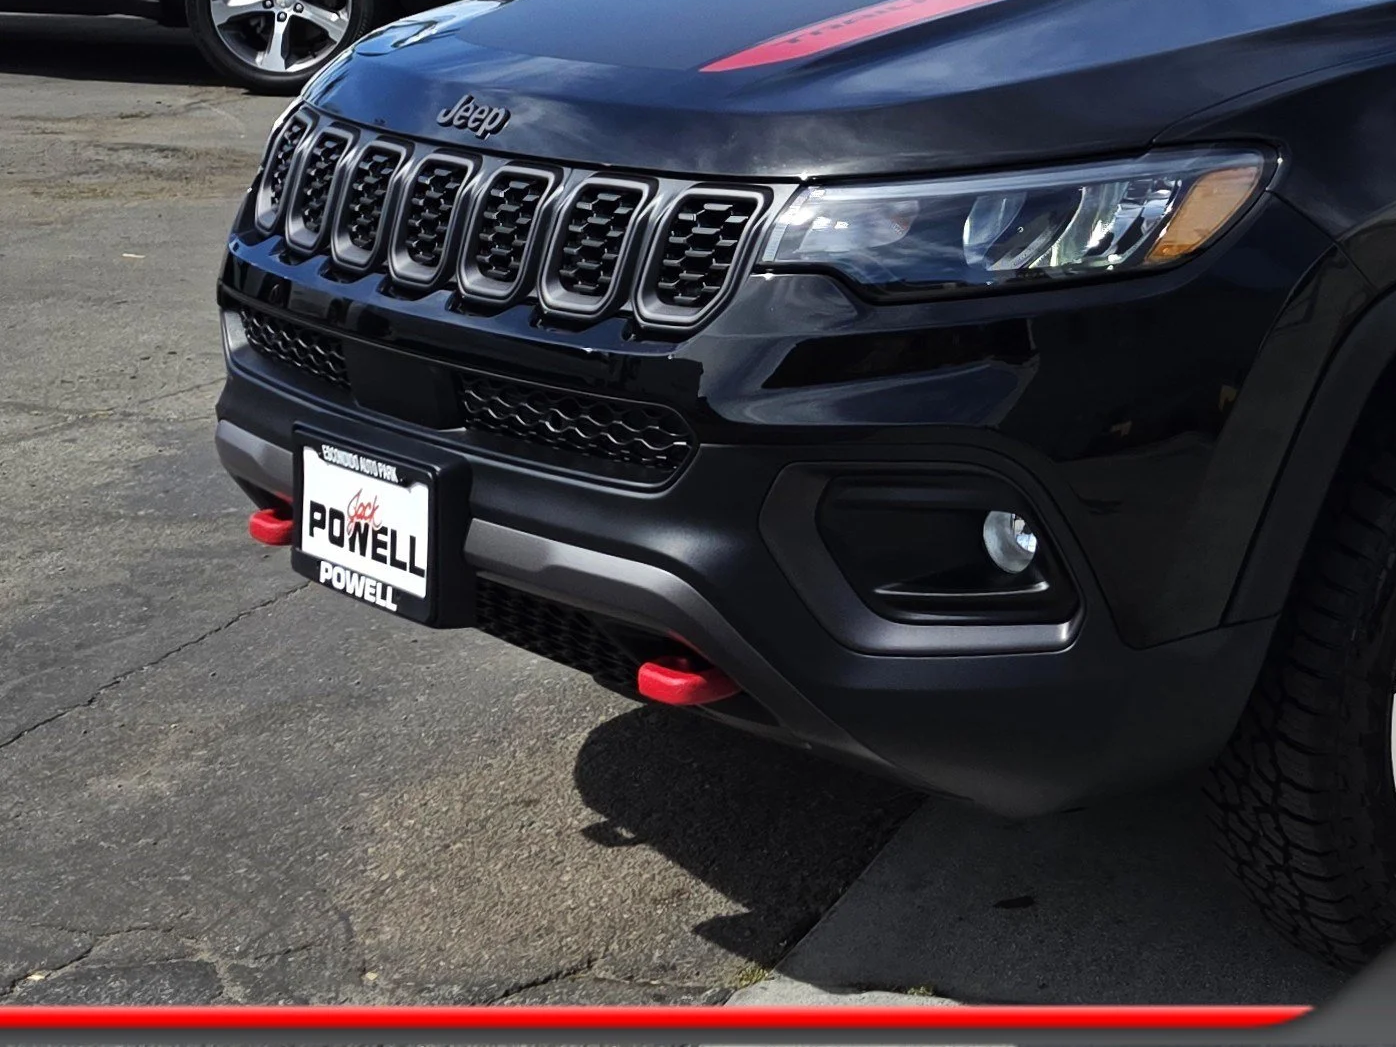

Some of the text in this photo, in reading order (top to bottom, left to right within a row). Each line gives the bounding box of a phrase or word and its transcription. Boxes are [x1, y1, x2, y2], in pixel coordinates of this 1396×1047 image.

[436, 94, 510, 140] Jeep
[347, 488, 382, 535] Jack
[309, 500, 426, 579] POWELL
[319, 560, 398, 612] POWELL
